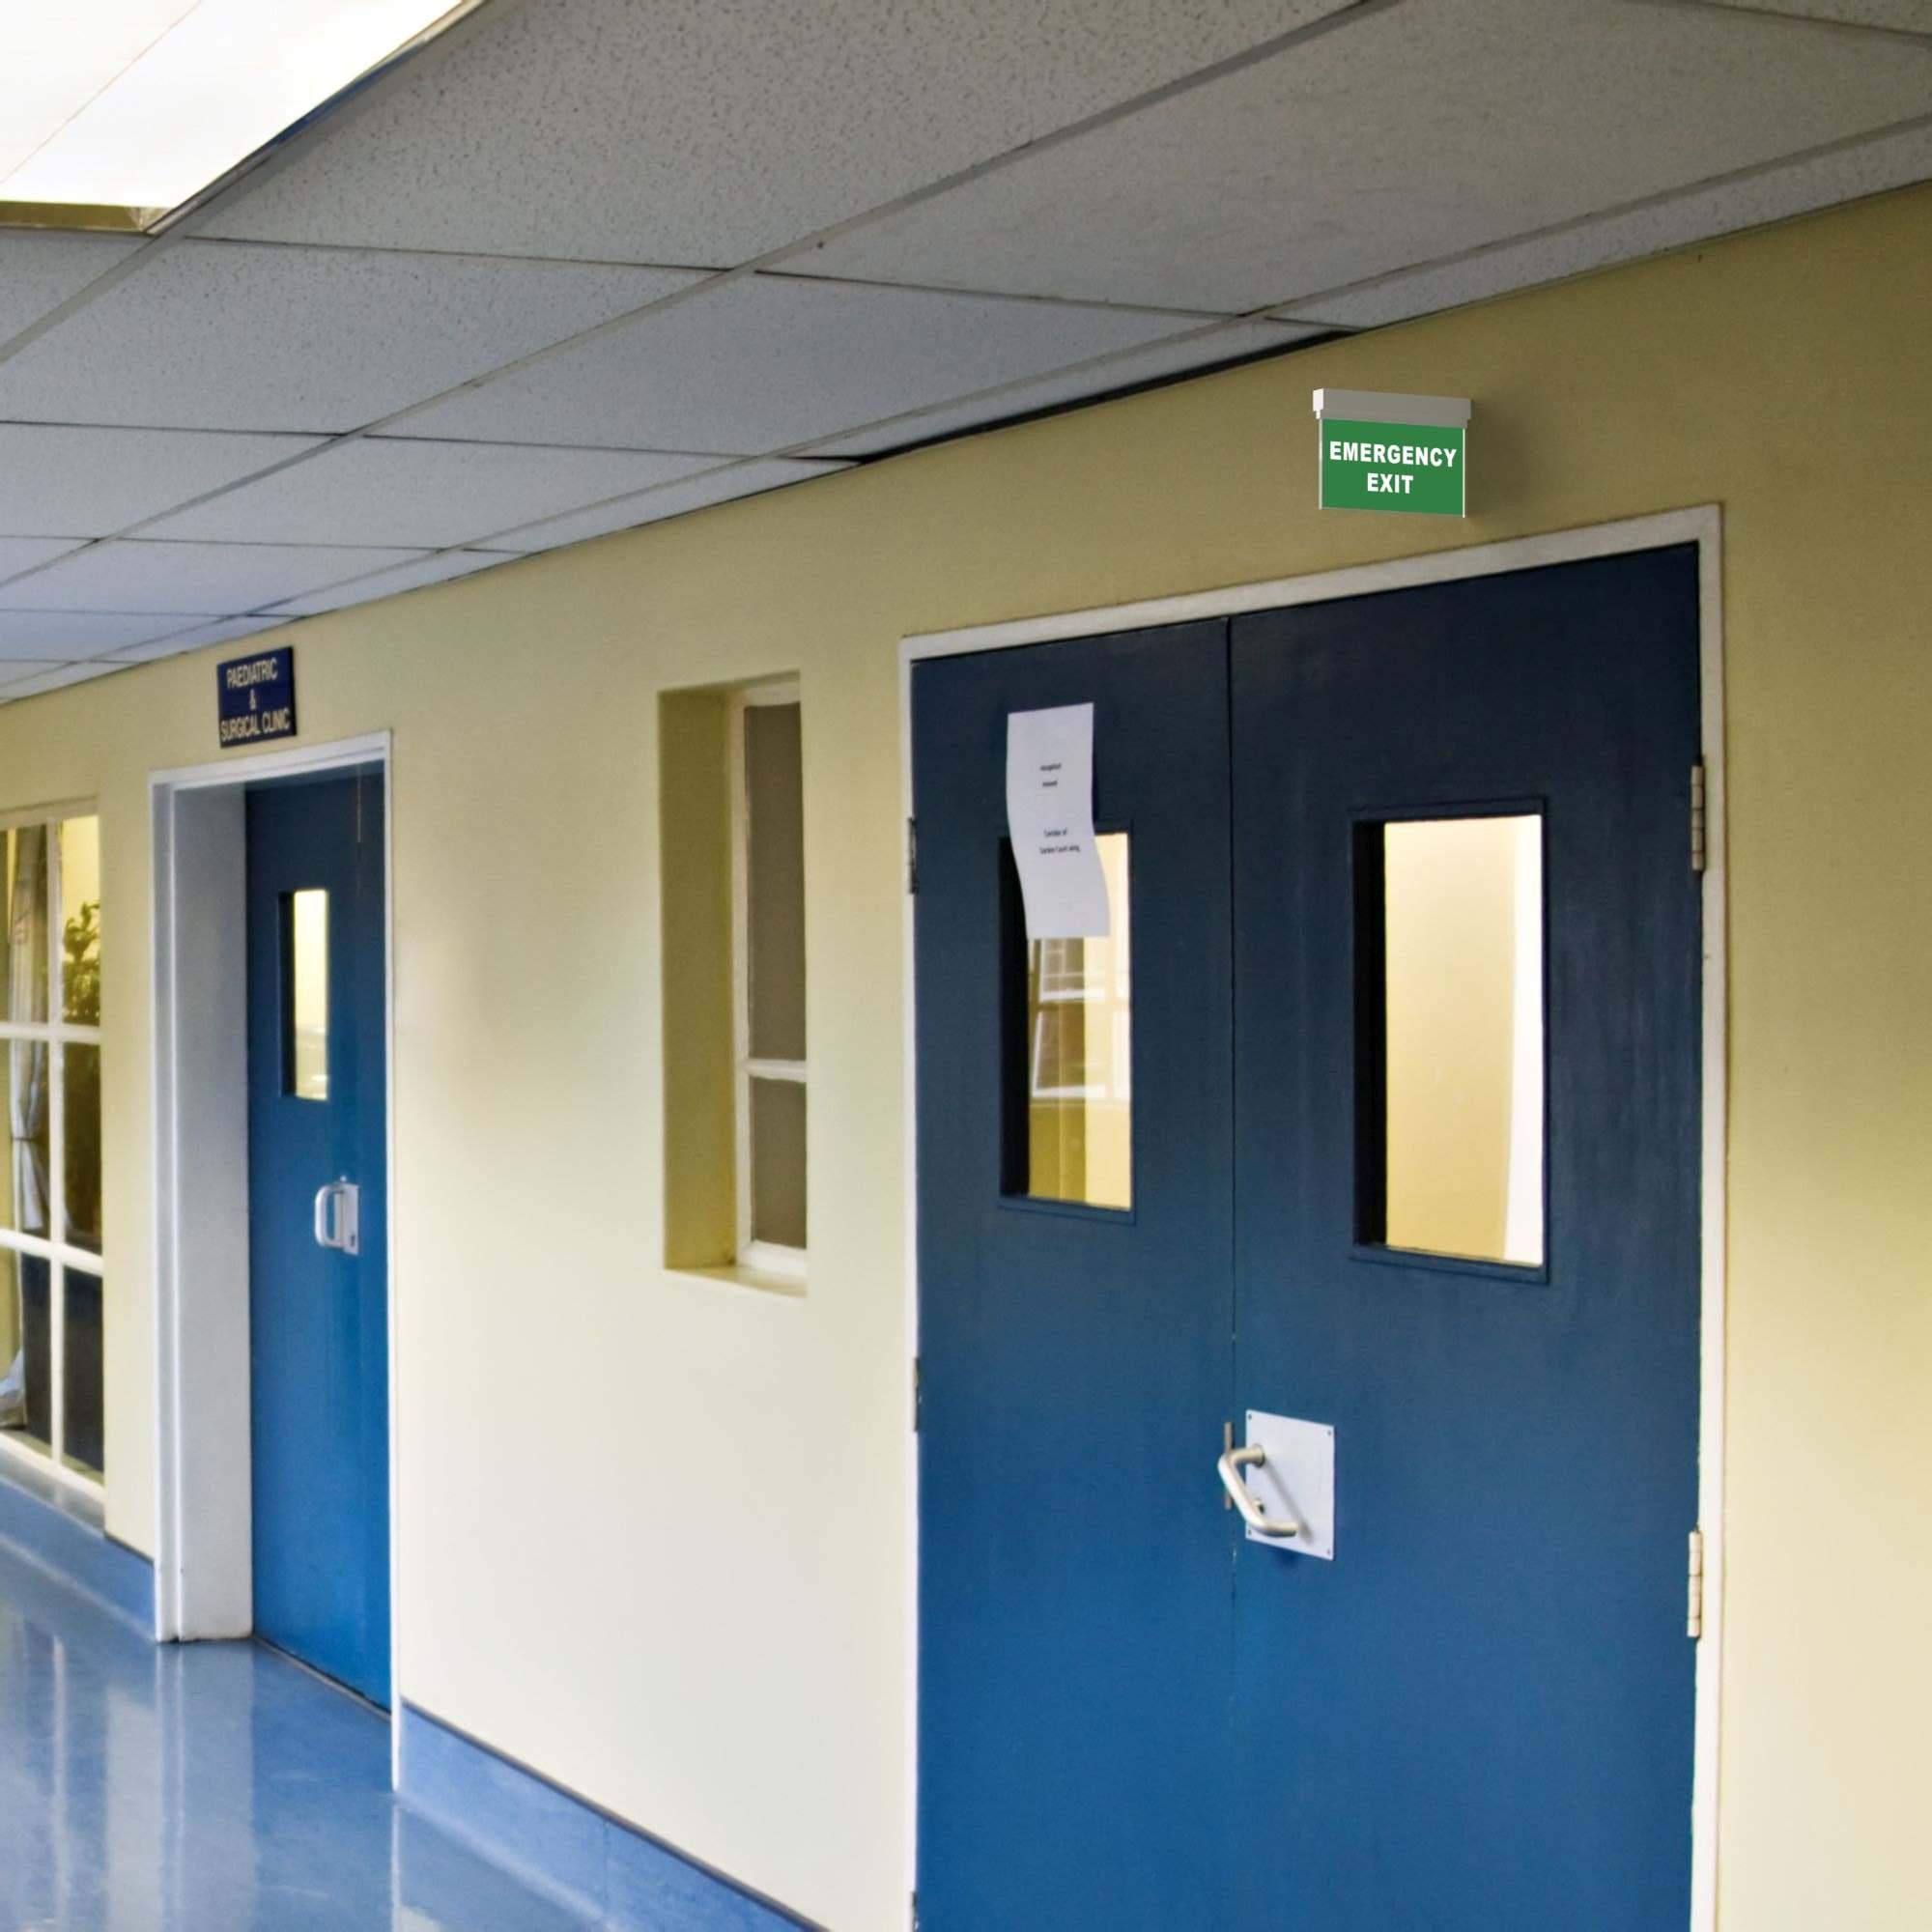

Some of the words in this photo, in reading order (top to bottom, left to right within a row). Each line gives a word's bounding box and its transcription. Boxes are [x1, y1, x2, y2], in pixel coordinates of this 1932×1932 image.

[1329, 440, 1457, 468] EMERGENCY
[1367, 472, 1414, 494] EXIT
[226, 658, 278, 689] PAEDIATRIC
[249, 689, 257, 710] &
[221, 714, 261, 742] SURGICAL
[262, 707, 291, 733] CLINIC
